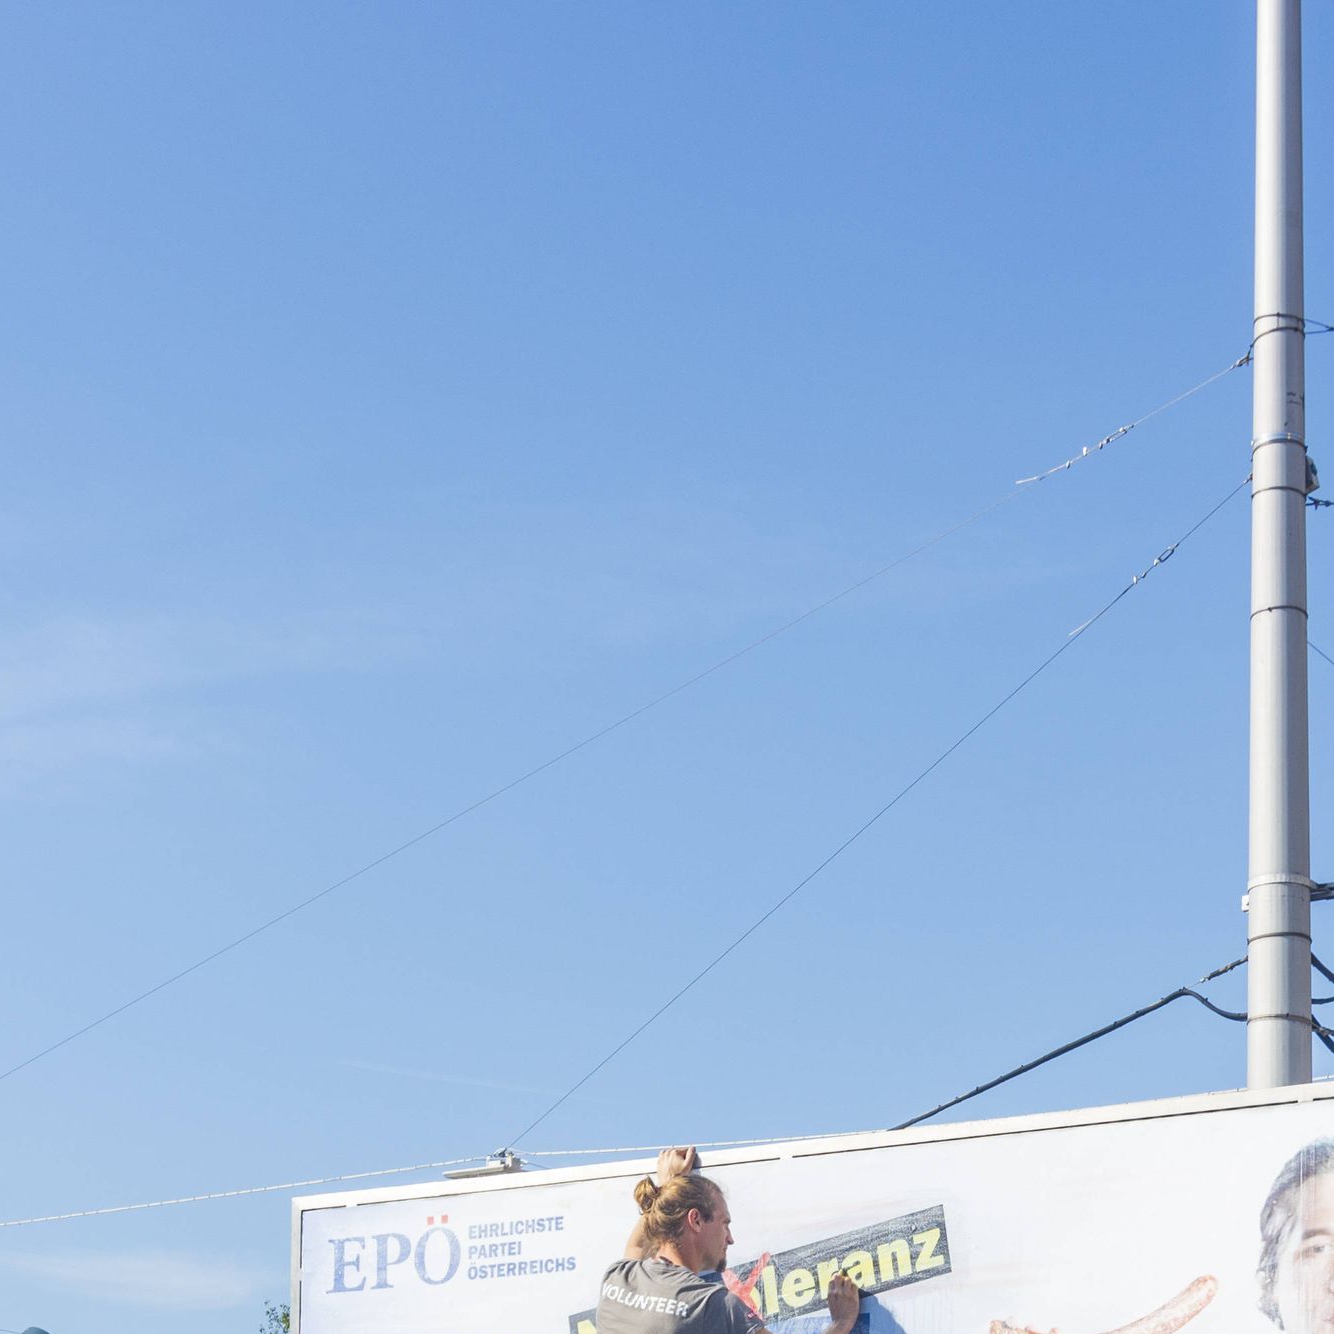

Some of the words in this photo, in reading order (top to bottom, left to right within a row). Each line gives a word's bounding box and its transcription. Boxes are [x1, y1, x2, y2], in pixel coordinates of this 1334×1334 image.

[468, 1216, 565, 1240] EHRLICHSTE
[325, 1214, 462, 1295] EPÖ
[468, 1241, 522, 1260] PARTEI
[467, 1256, 577, 1281] ÖSTERREICHS
[601, 1282, 689, 1318] VOLUNTEER
